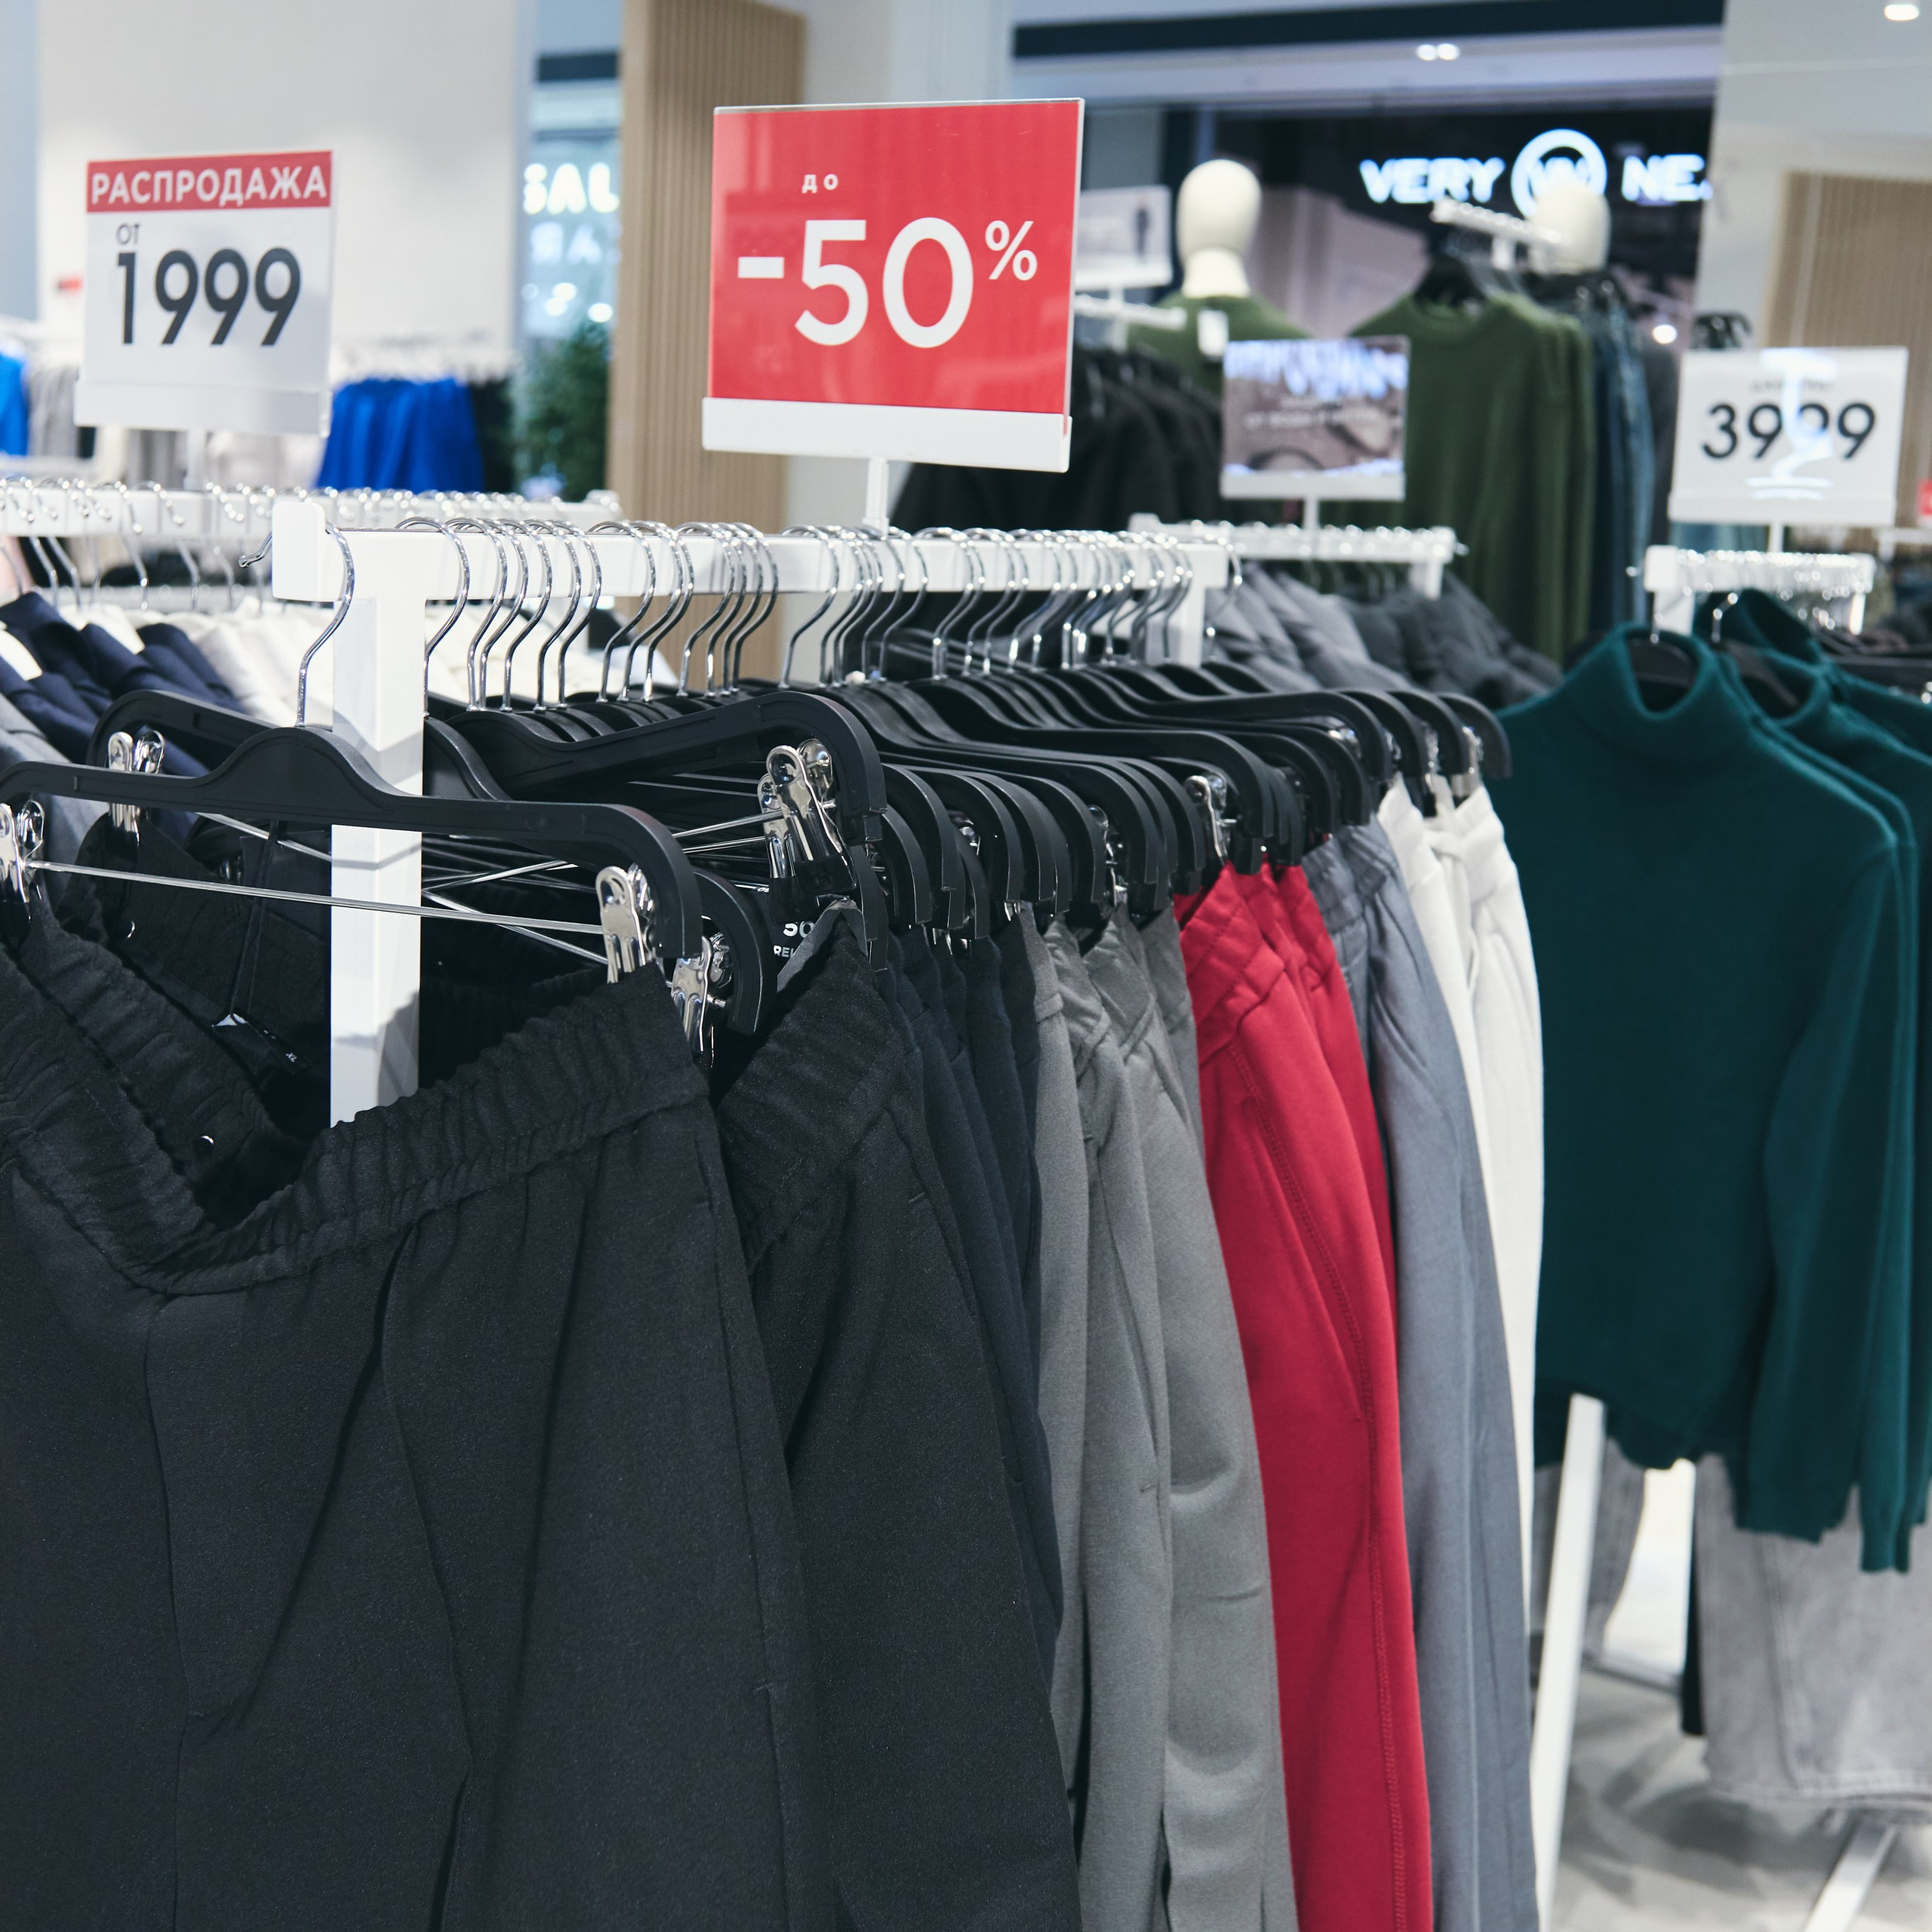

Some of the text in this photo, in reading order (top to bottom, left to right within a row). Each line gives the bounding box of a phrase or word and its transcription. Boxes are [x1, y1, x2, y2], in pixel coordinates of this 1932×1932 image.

[91, 164, 328, 208] РАСПРОДАЖА
[1359, 157, 1505, 203] VERY
[1621, 154, 1713, 202] NE
[118, 247, 302, 346] 1999
